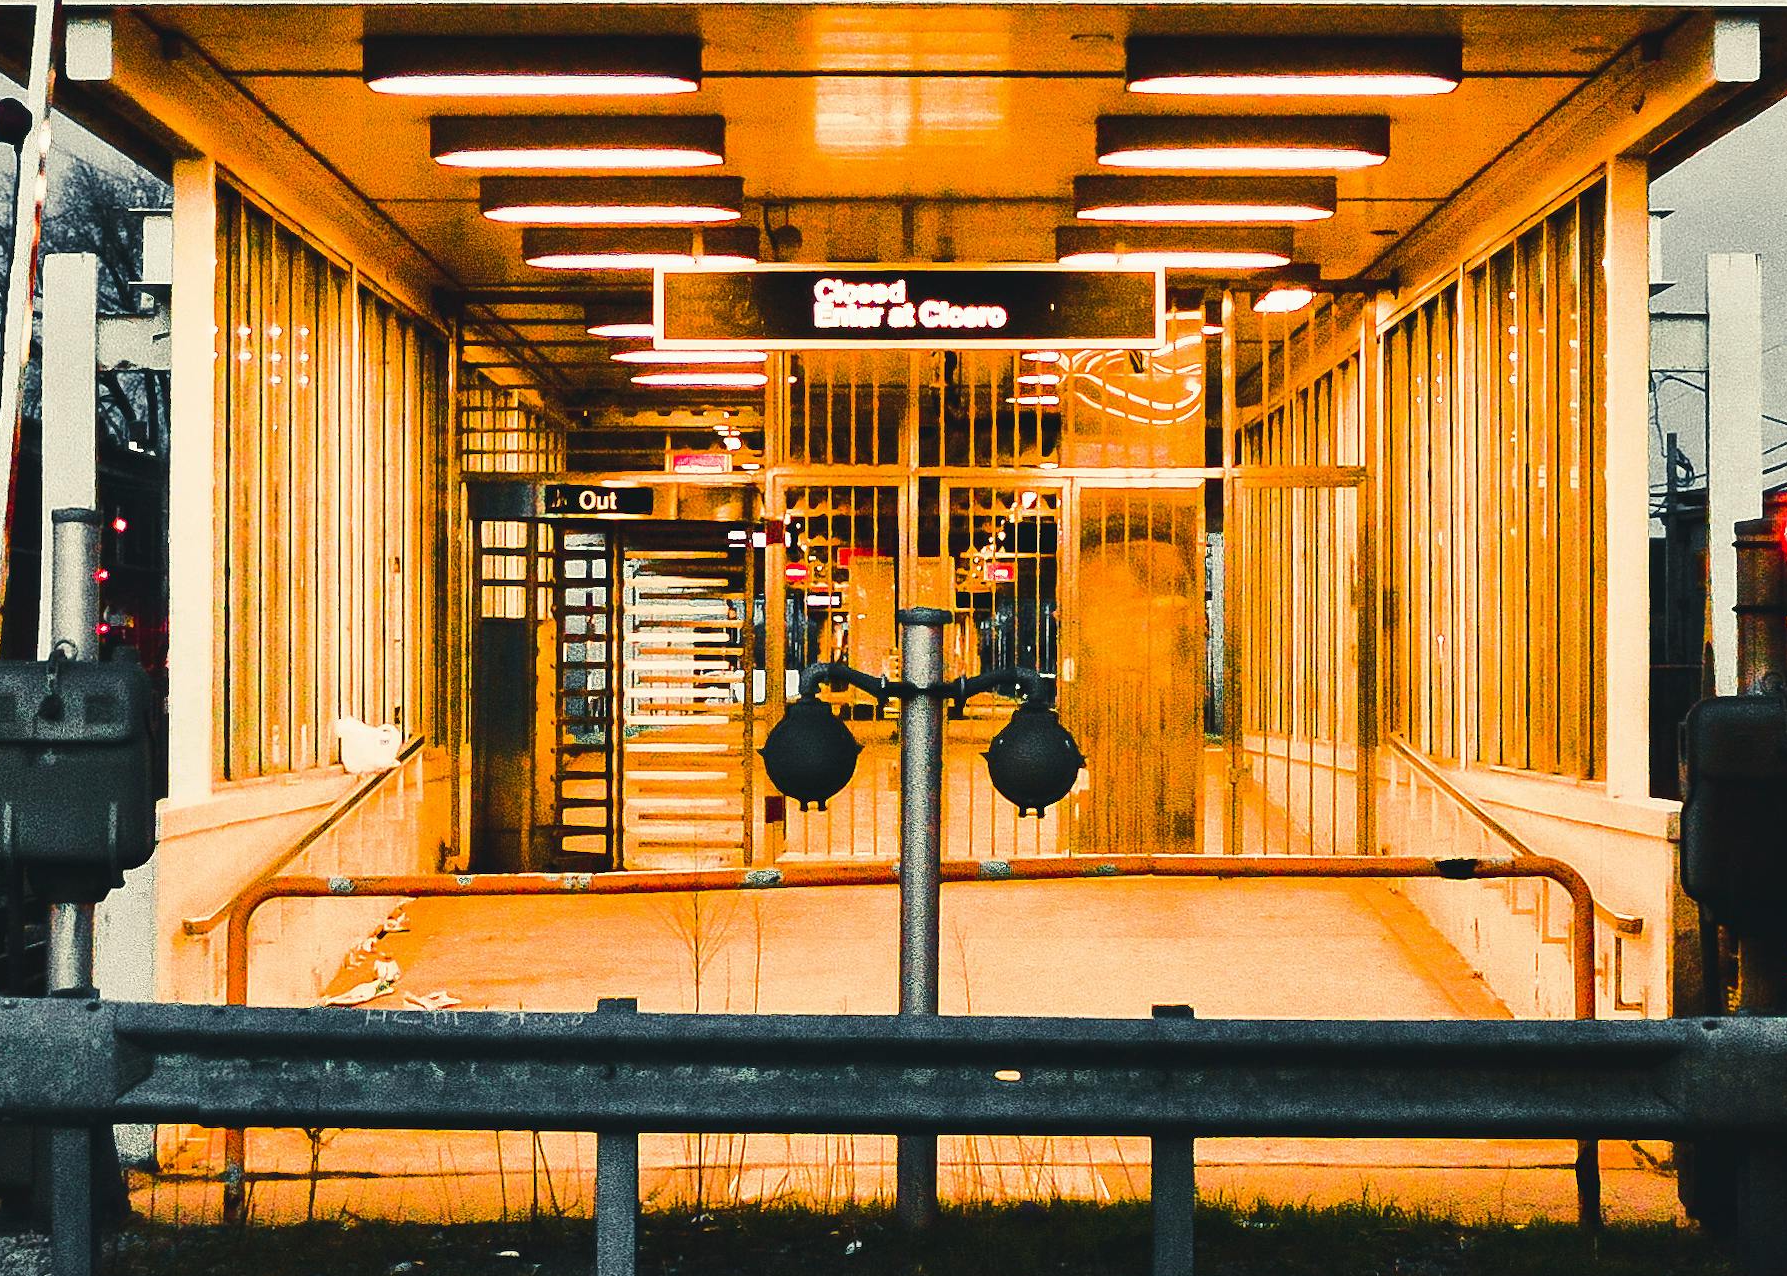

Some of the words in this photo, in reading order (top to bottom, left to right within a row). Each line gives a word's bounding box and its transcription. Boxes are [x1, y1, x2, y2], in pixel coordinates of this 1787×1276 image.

[814, 278, 907, 304] Closed
[814, 301, 885, 328] Enter
[887, 302, 916, 328] at
[579, 490, 617, 510] Out
